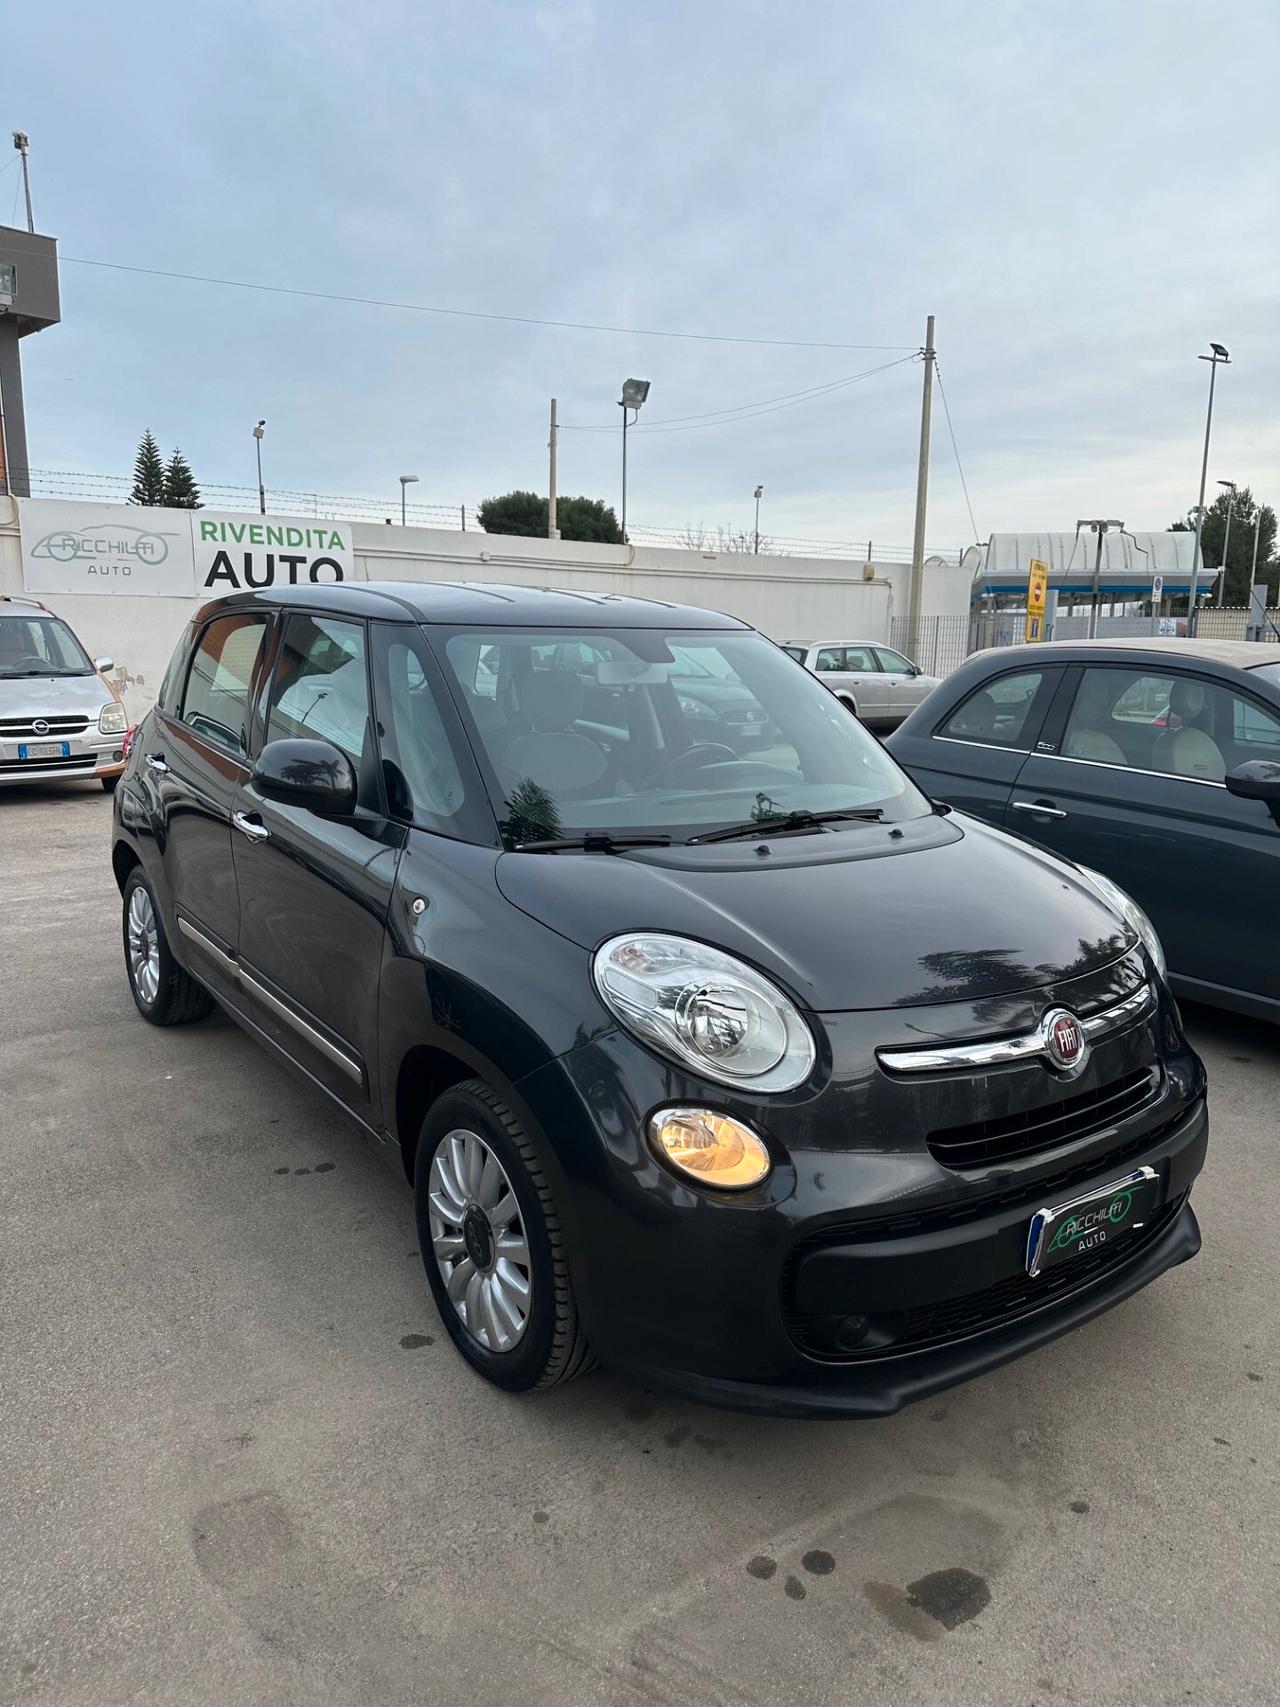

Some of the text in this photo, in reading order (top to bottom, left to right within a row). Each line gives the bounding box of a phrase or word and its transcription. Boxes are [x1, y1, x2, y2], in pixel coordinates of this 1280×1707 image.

[200, 520, 345, 550] RIVENDITA
[87, 565, 131, 576] AUTO
[204, 550, 344, 588] AUTO
[1057, 1027, 1077, 1052] FIAT
[1078, 1230, 1107, 1252] AUTO
